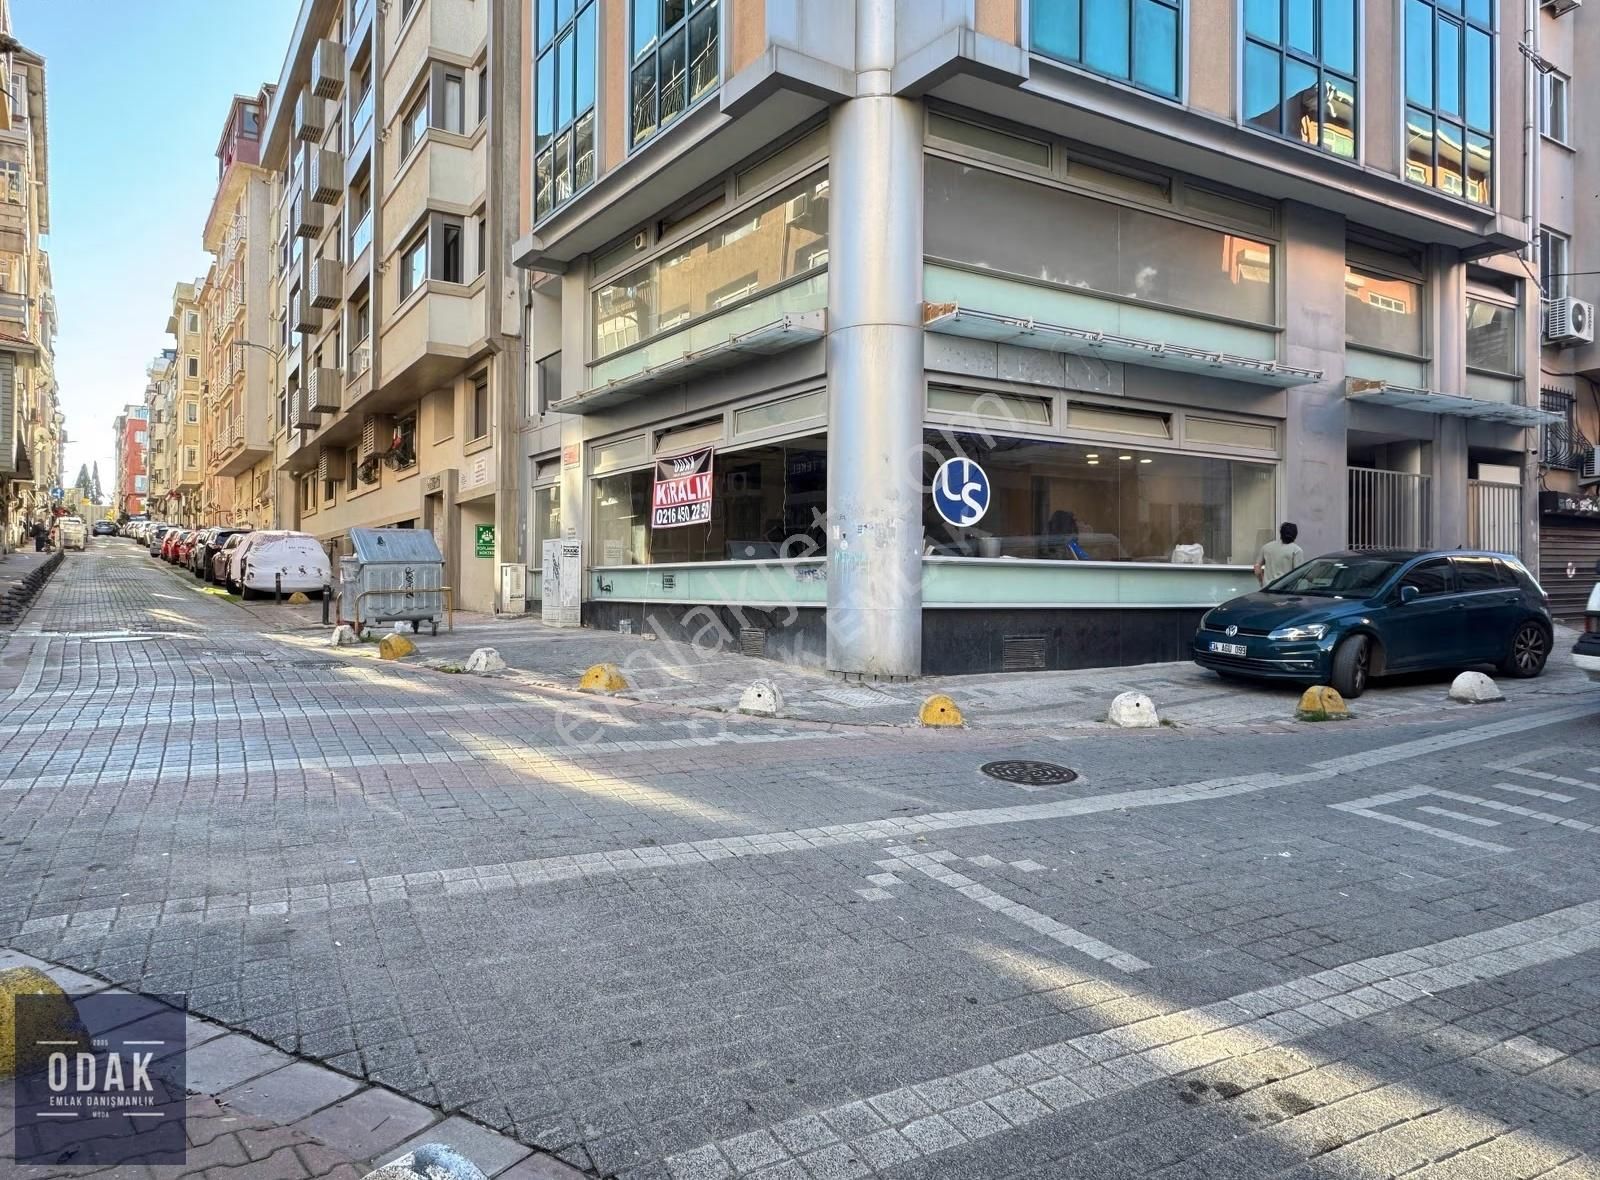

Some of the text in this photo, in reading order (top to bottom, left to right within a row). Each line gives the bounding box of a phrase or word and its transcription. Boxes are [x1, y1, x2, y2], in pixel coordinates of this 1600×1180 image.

[674, 456, 695, 473] ODAK
[657, 508, 676, 524] 0216
[678, 506, 690, 522] 450
[691, 503, 700, 520] 22
